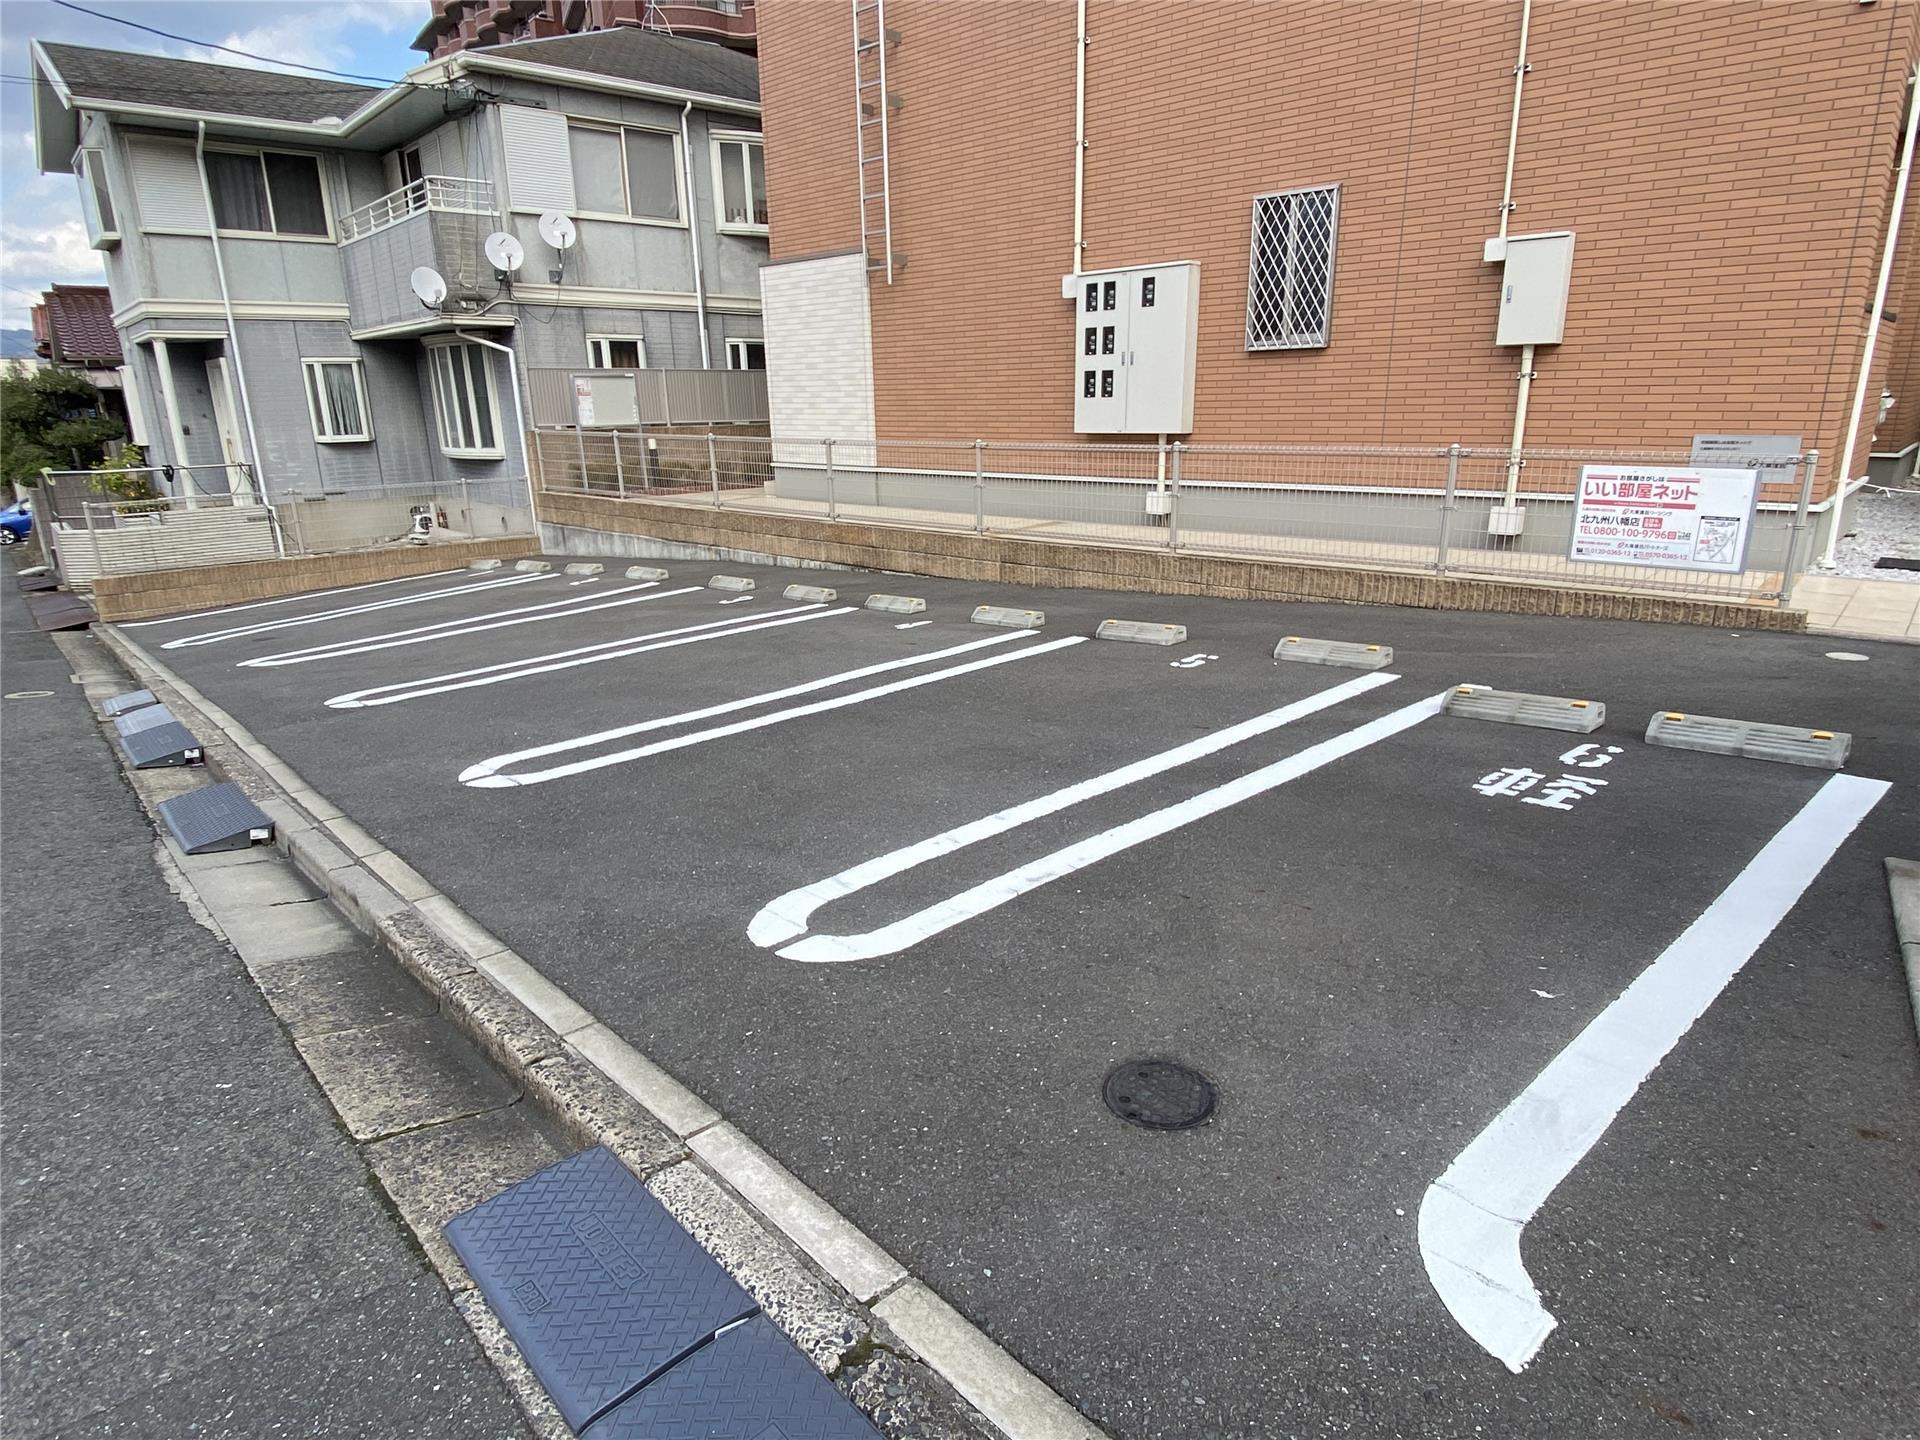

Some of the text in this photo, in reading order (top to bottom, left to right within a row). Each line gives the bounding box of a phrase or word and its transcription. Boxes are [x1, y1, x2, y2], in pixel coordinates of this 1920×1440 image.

[1584, 481, 1698, 500] いい部屋ネット
[1580, 514, 1640, 526] 北九州八幡店
